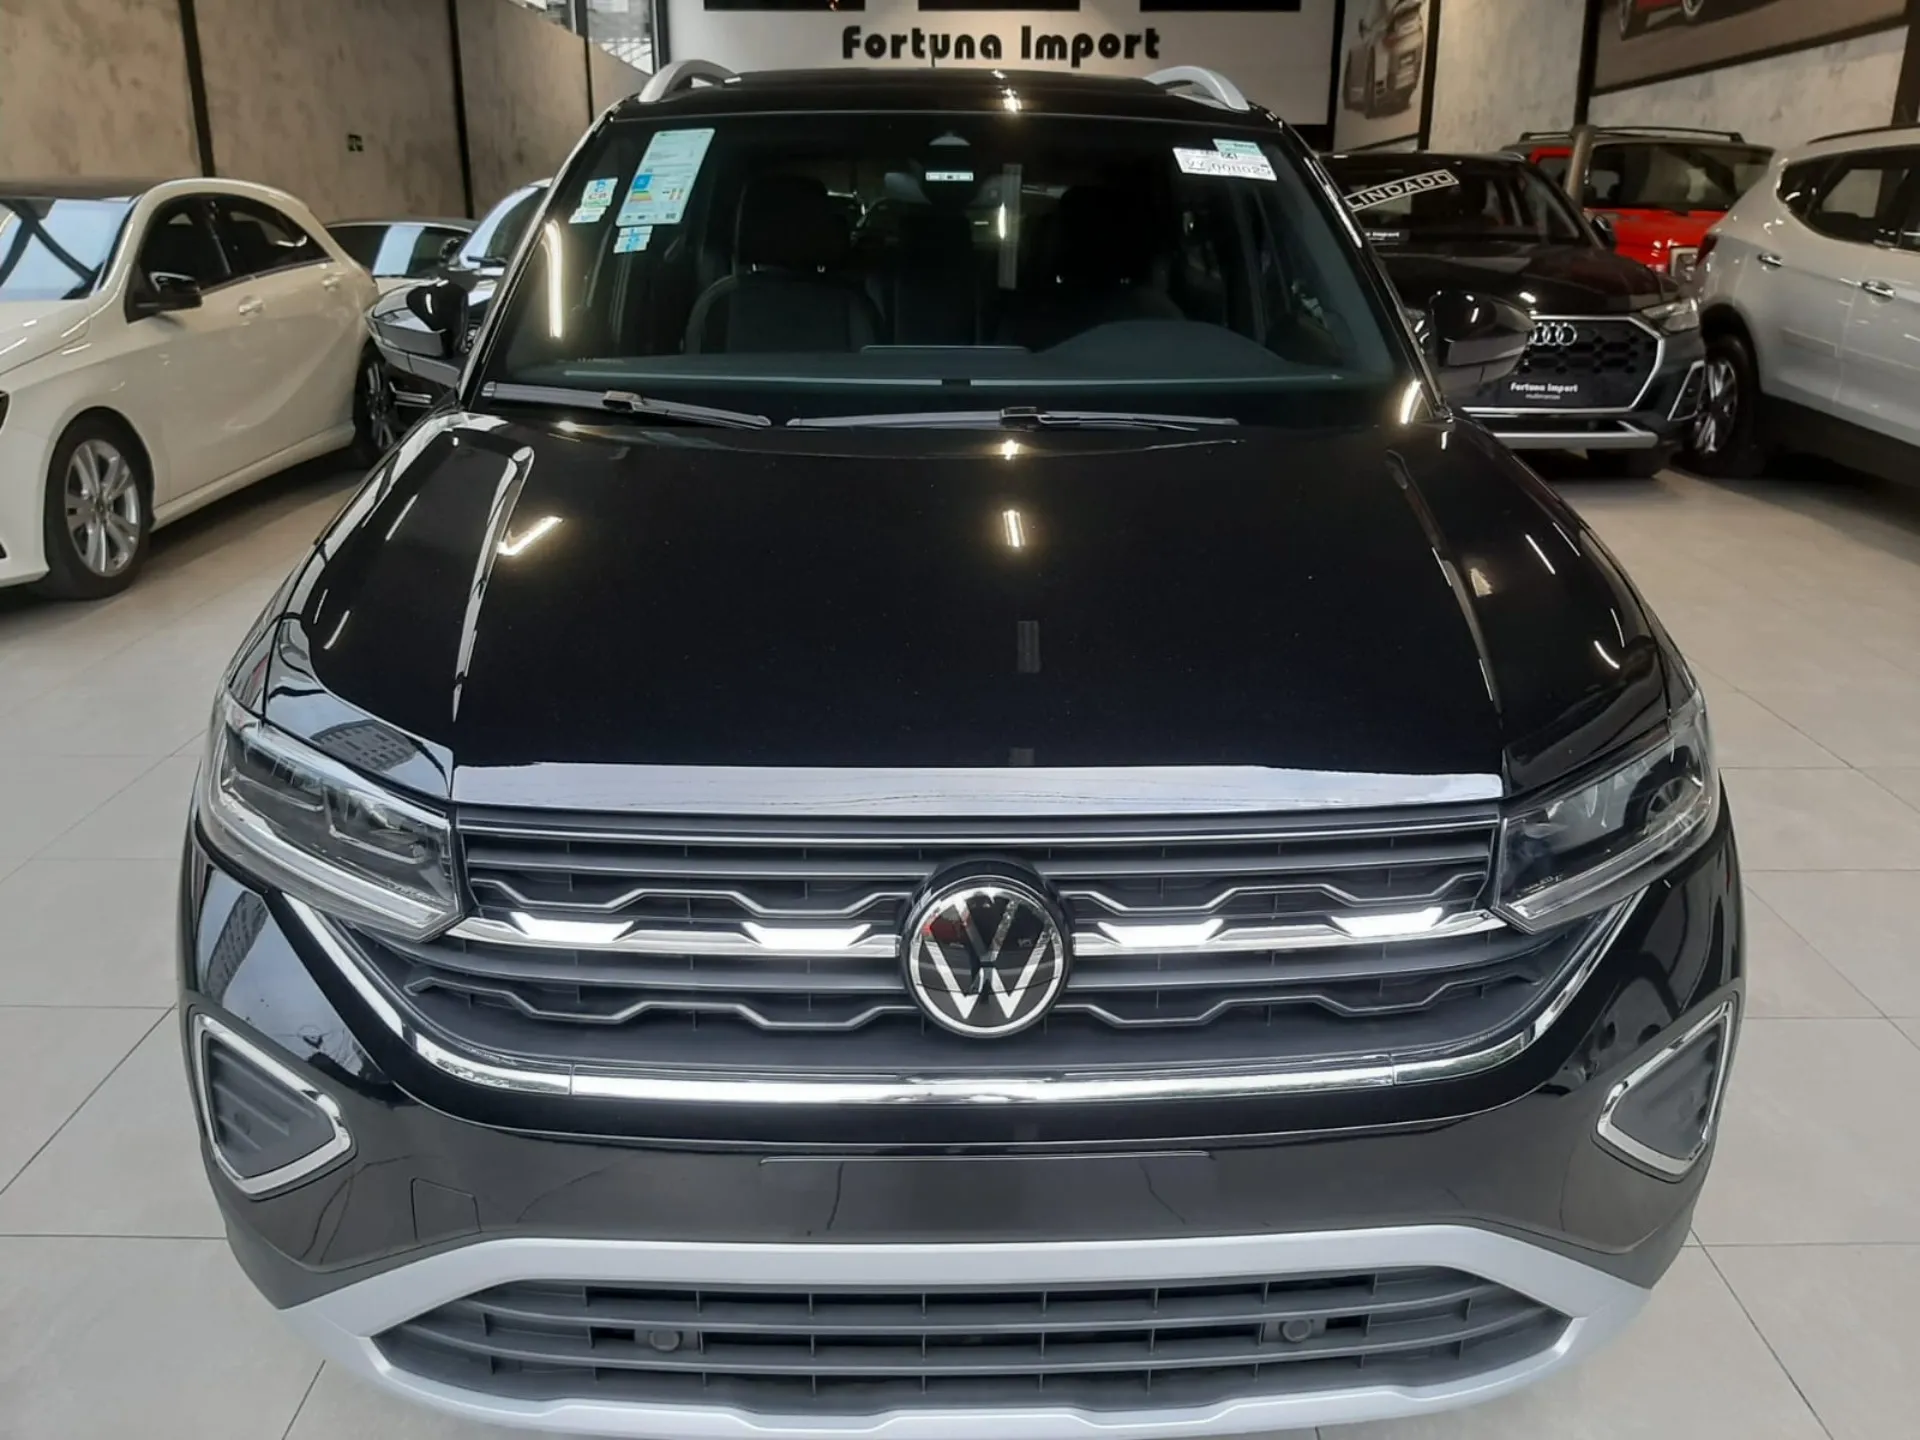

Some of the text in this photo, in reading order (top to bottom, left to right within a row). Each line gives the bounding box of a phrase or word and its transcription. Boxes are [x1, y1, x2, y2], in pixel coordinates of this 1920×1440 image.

[842, 26, 1160, 68] Fortuna Import
[1345, 173, 1452, 208] LINDADO
